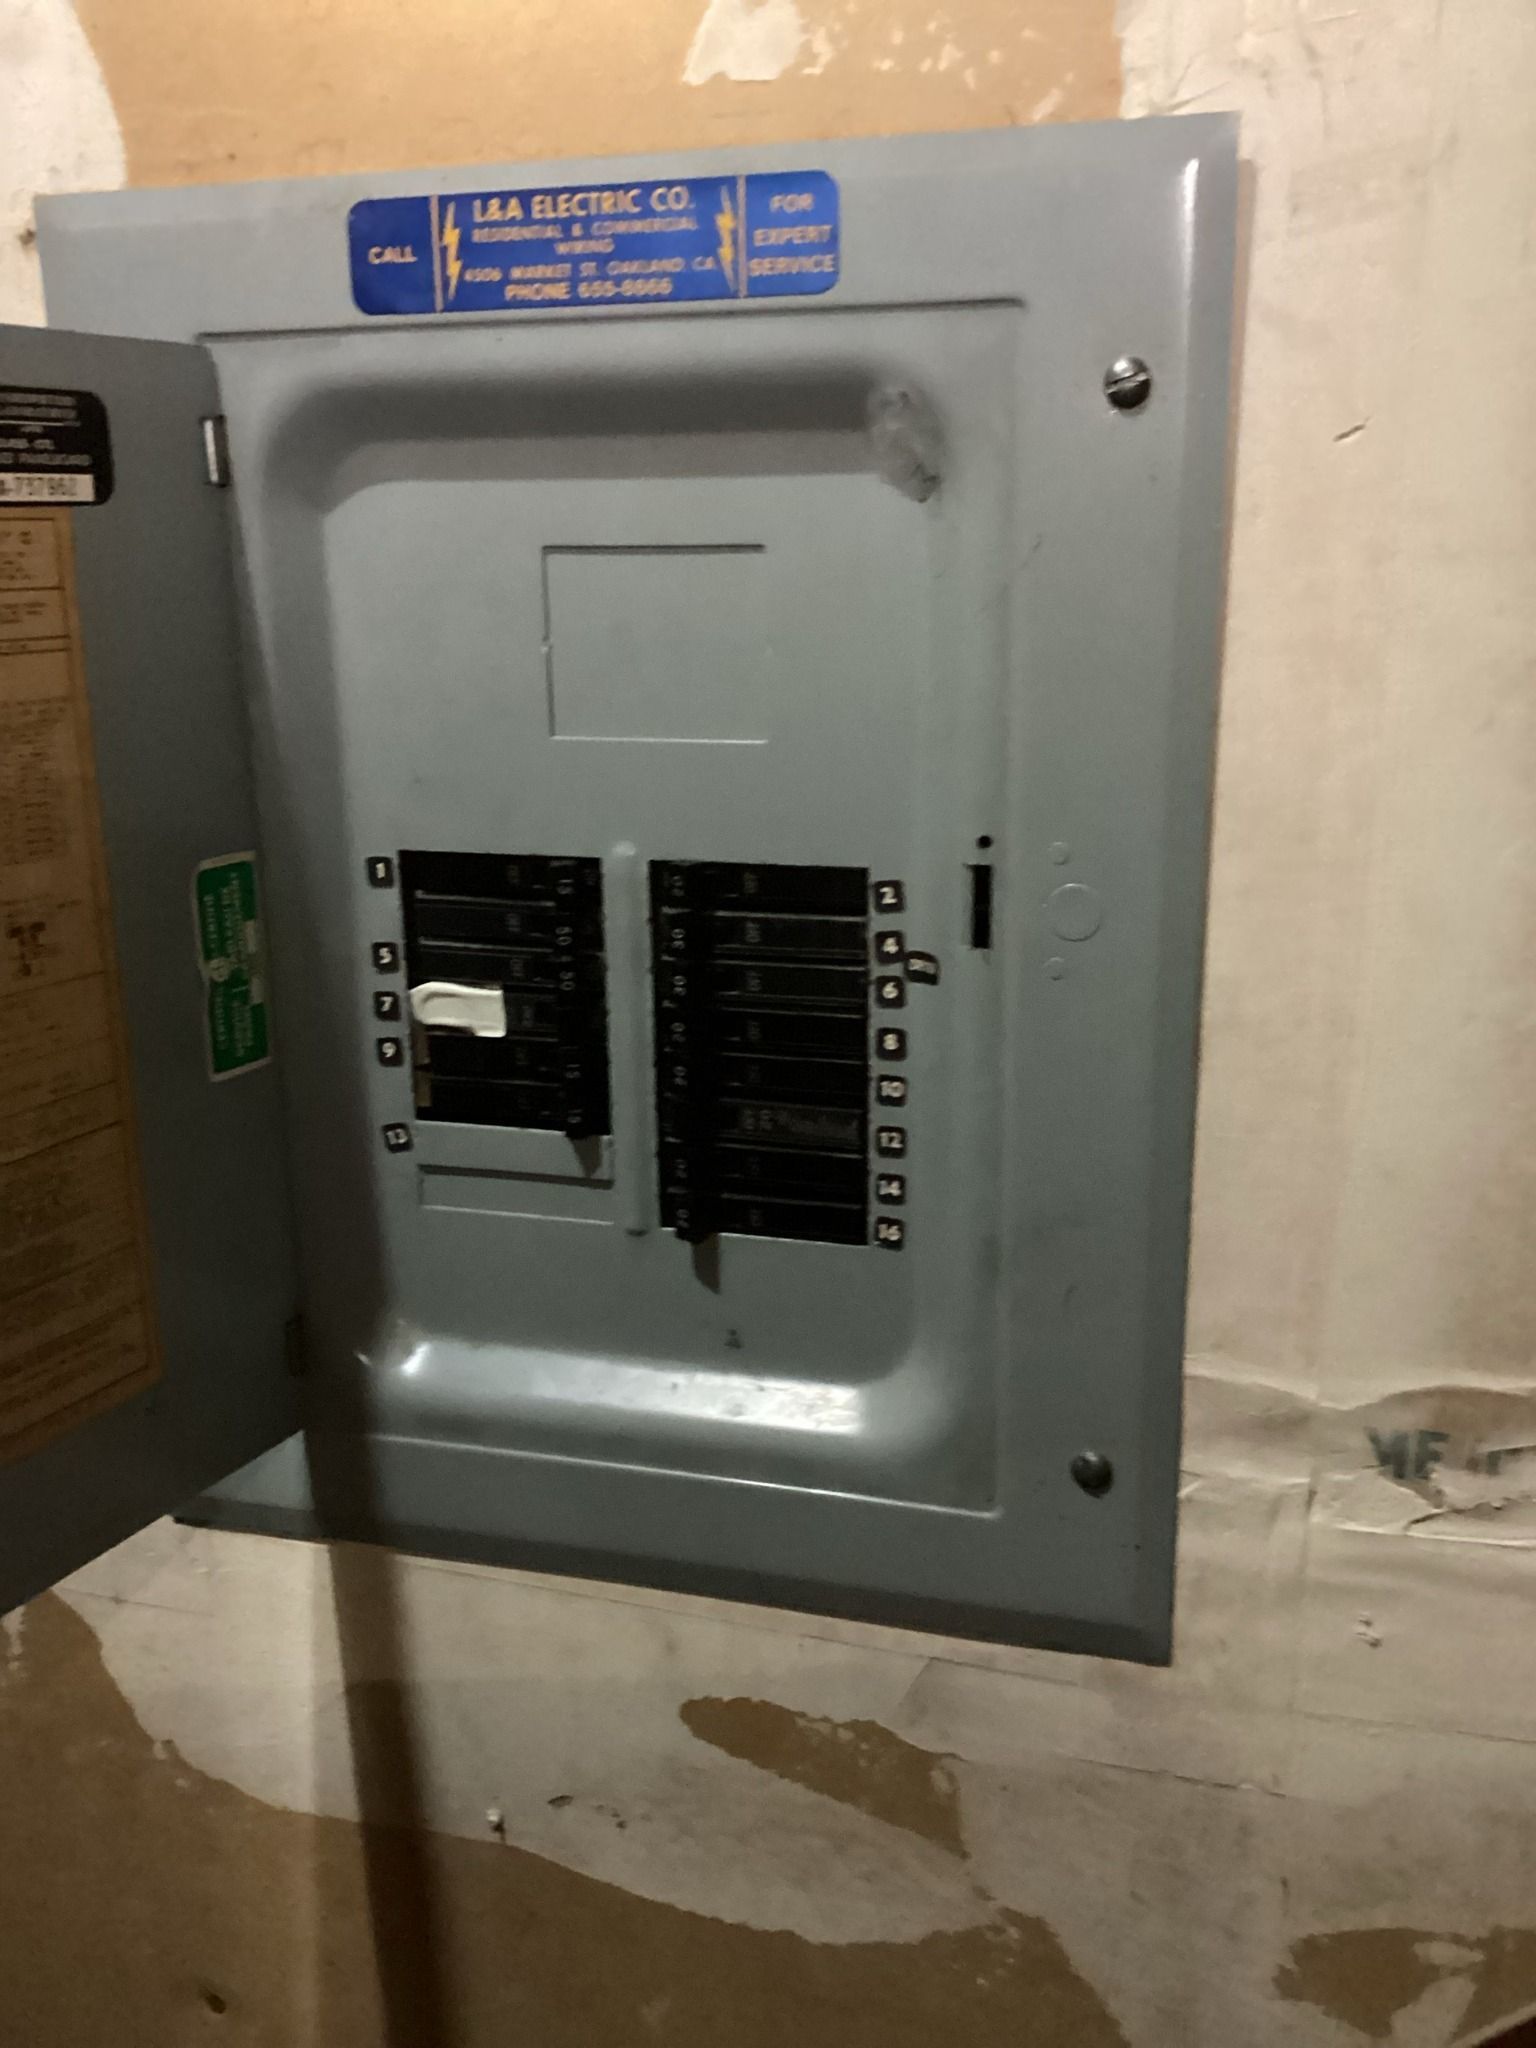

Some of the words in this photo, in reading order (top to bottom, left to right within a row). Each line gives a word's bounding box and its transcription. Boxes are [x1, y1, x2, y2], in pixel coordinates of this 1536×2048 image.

[473, 196, 523, 223] L&A
[531, 188, 642, 219] ELECTRIC
[650, 186, 696, 211] CO.
[769, 193, 814, 213] FOR
[591, 217, 698, 236] COMMERCIAL
[753, 225, 832, 246] EXPERT
[368, 245, 418, 264] CALL
[750, 254, 835, 276] SERVICE
[504, 281, 571, 300] PHONE
[375, 862, 386, 879] 1
[879, 886, 898, 904] 2
[882, 937, 899, 954] 4
[379, 947, 393, 964] 5
[882, 982, 899, 999] 6
[380, 996, 394, 1012] 7
[382, 1042, 397, 1058] 9
[883, 1034, 899, 1050] 8
[880, 1081, 905, 1097] 10
[880, 1131, 904, 1148] 12
[879, 1180, 901, 1196] 14
[878, 1223, 901, 1241] 16
